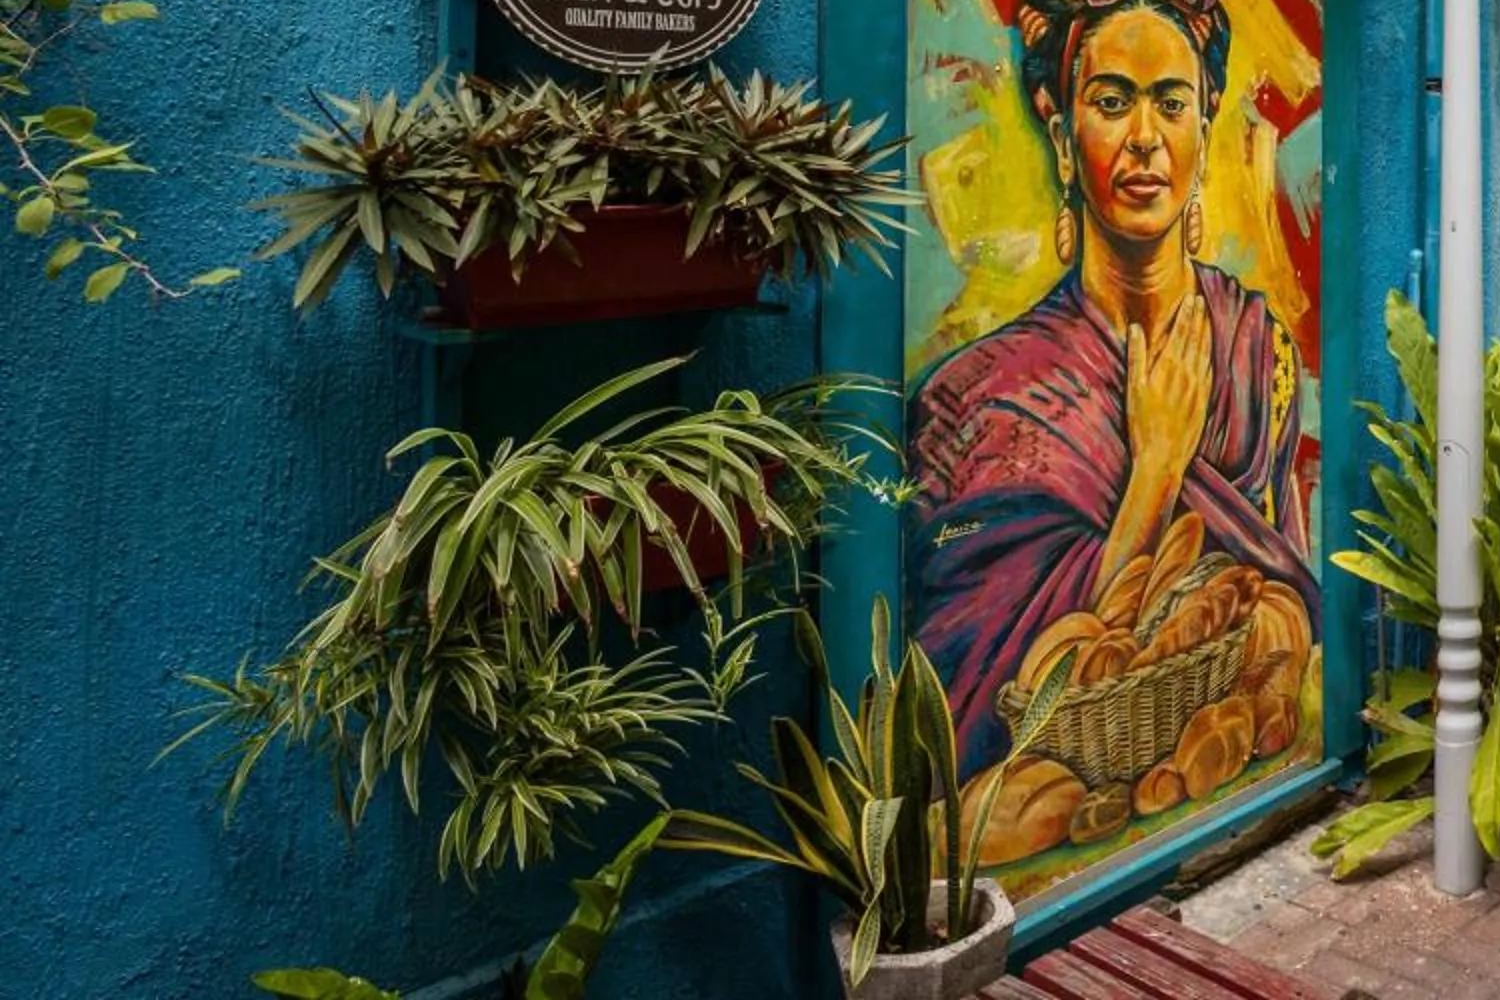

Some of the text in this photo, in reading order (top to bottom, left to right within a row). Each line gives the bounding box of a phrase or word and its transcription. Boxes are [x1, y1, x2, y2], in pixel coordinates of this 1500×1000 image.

[564, 6, 695, 32] QUALITY FAMILY BAKERS
